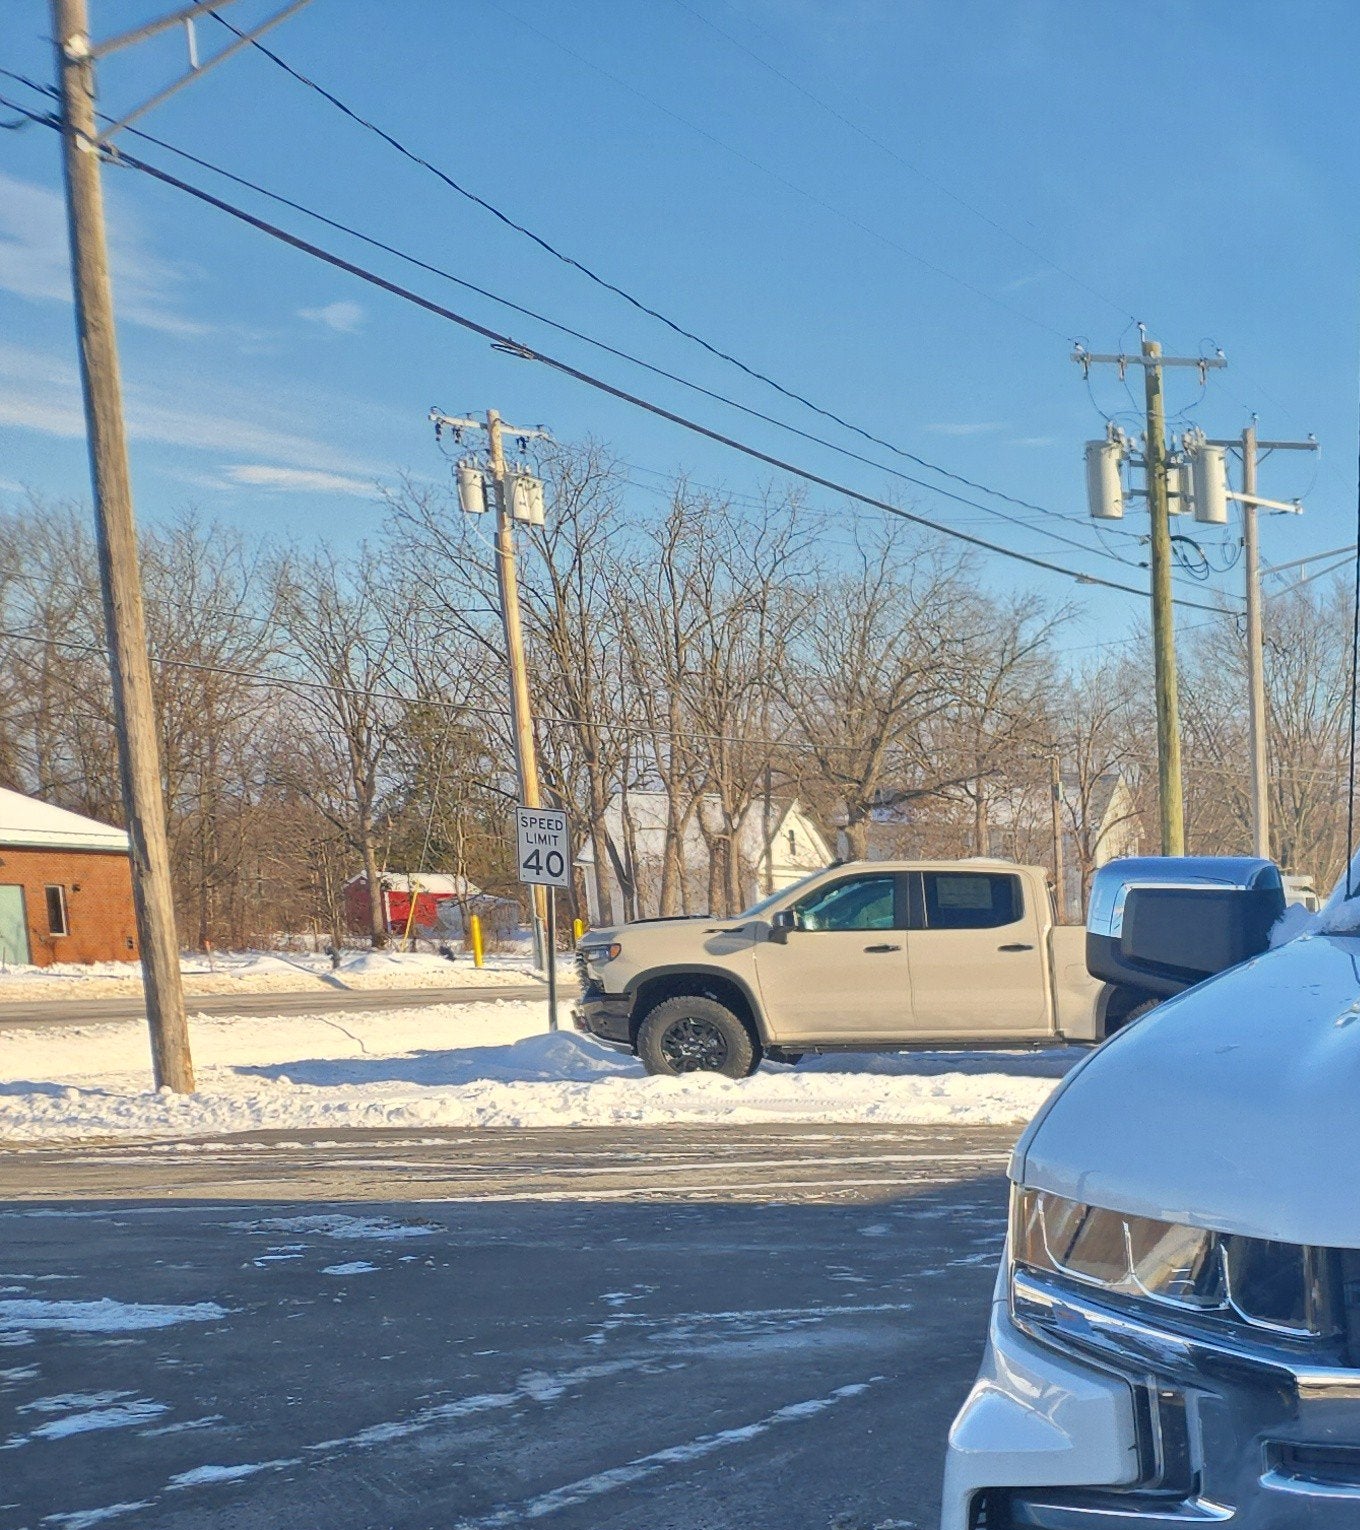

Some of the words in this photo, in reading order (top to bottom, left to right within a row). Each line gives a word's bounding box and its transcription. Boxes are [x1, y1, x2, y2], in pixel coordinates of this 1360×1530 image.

[521, 817, 563, 831] SPEED
[526, 832, 559, 846] LIMIT
[522, 849, 564, 877] 40
